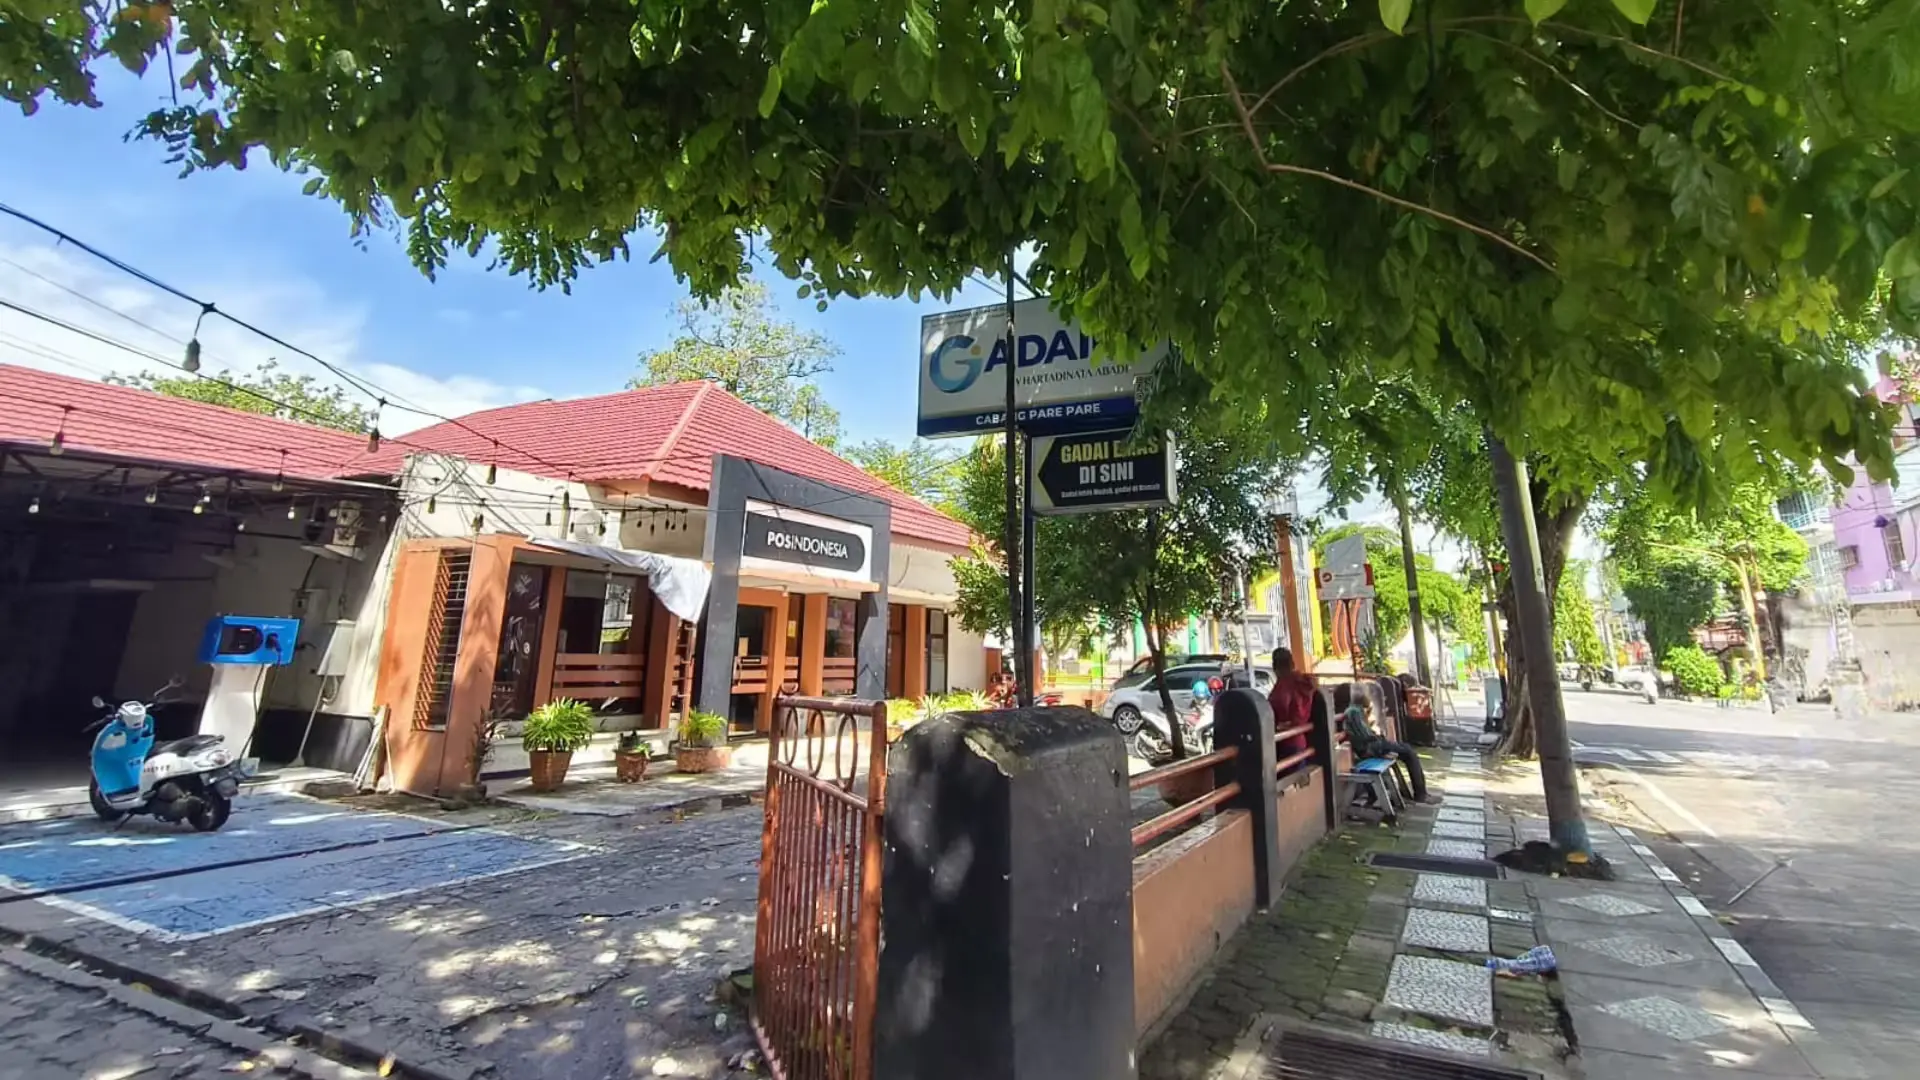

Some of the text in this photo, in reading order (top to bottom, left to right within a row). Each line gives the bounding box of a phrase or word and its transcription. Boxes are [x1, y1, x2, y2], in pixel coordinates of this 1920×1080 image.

[929, 328, 1148, 394] GADAI
[975, 402, 1101, 426] CABAG PARE PARE
[1061, 441, 1109, 464] GADAI
[1079, 461, 1134, 485] DI SINI
